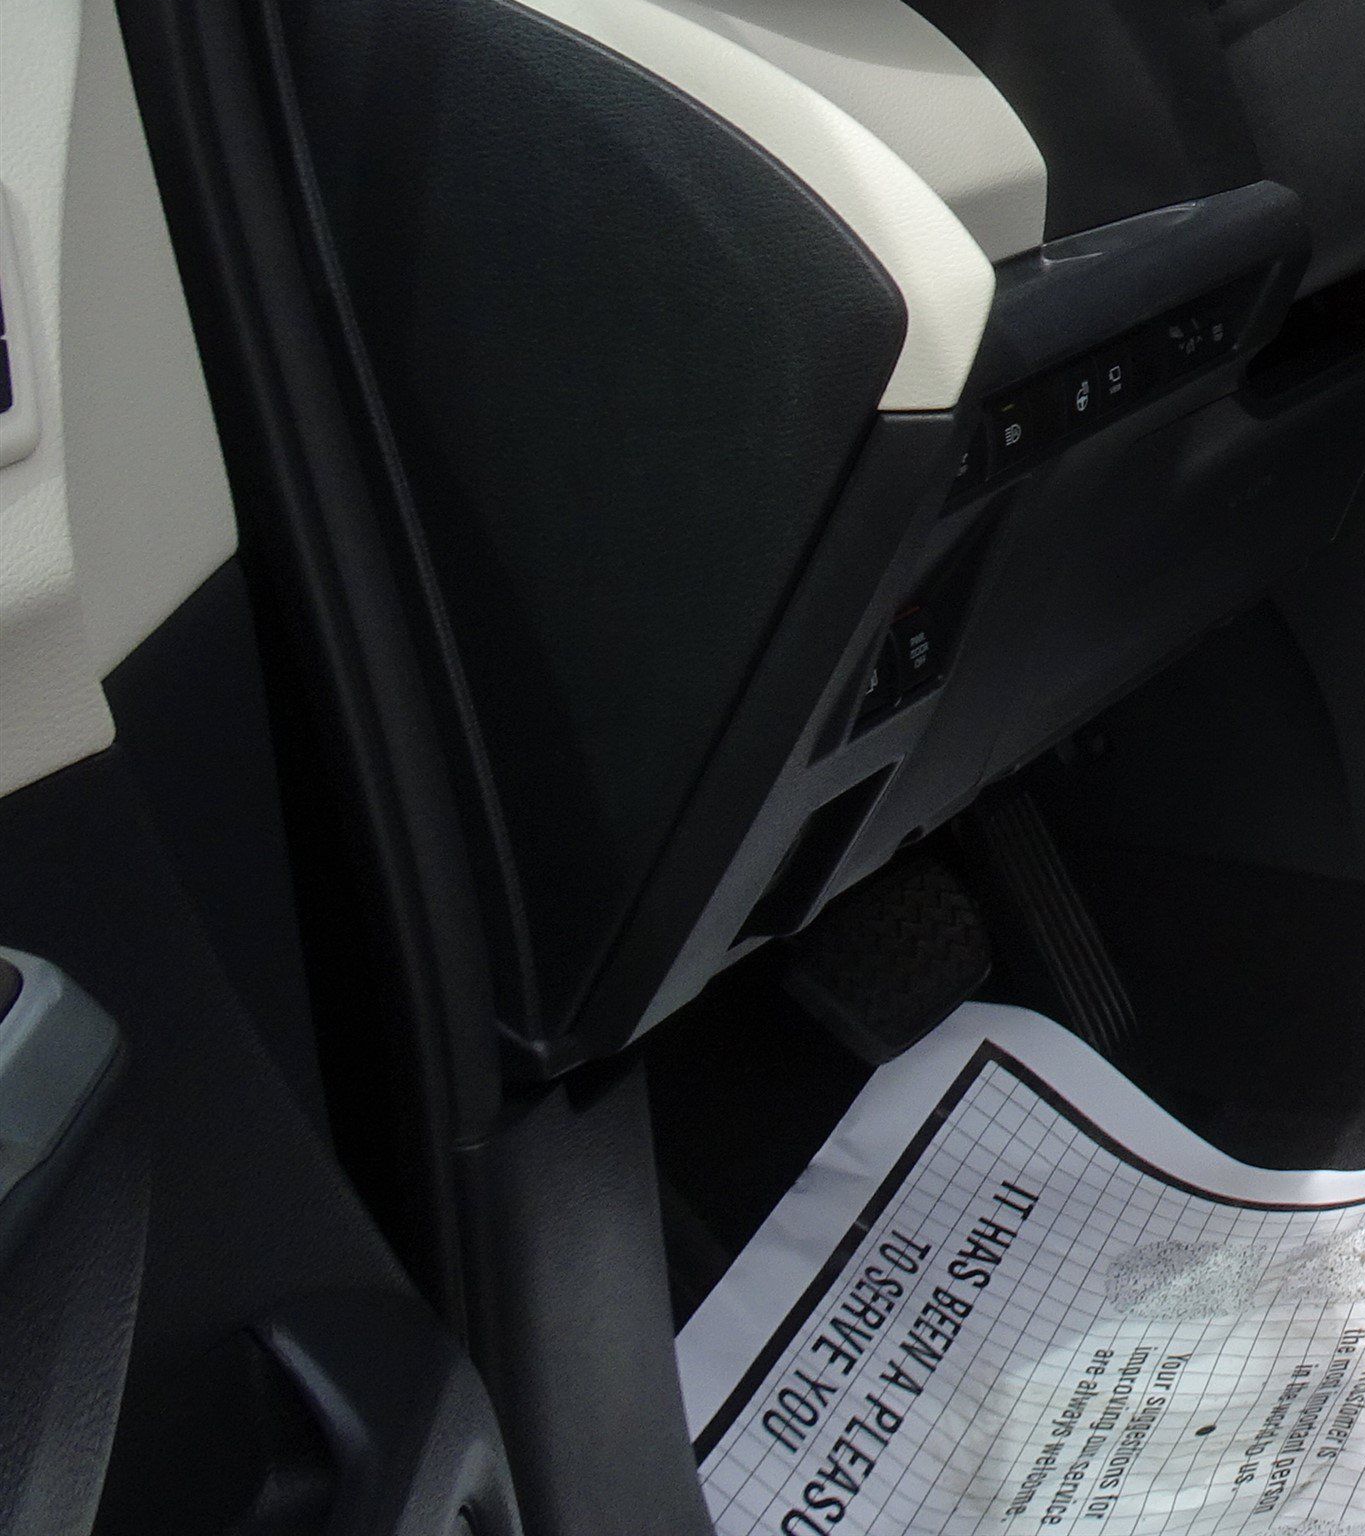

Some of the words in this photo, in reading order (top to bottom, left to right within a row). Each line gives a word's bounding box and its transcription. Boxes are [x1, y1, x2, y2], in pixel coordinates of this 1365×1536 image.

[993, 1180, 1039, 1220] IT
[879, 1230, 932, 1275] TO
[948, 1217, 1018, 1289] HAS
[811, 1266, 905, 1375] SERVE
[899, 1286, 974, 1373] BEEN
[1338, 1328, 1365, 1354] the
[879, 1360, 924, 1396] A
[1086, 1349, 1114, 1376] are
[1153, 1353, 1193, 1391] Your
[1291, 1364, 1319, 1379] in
[1320, 1359, 1350, 1390] most
[1051, 1379, 1099, 1438] always
[1090, 1346, 1159, 1432] improving
[1278, 1381, 1309, 1402] the
[762, 1370, 838, 1453] YOU
[1283, 1390, 1338, 1454] important
[1080, 1435, 1107, 1458] our
[1100, 1396, 1166, 1489] suggestions
[1245, 1441, 1273, 1457] to
[1317, 1446, 1346, 1460] is
[781, 1393, 904, 1536] PLEASU
[1000, 1442, 1066, 1524] welcome.
[1231, 1461, 1260, 1492] us.
[1253, 1457, 1295, 1514] person
[1041, 1459, 1090, 1525] service
[1085, 1493, 1119, 1519] for
